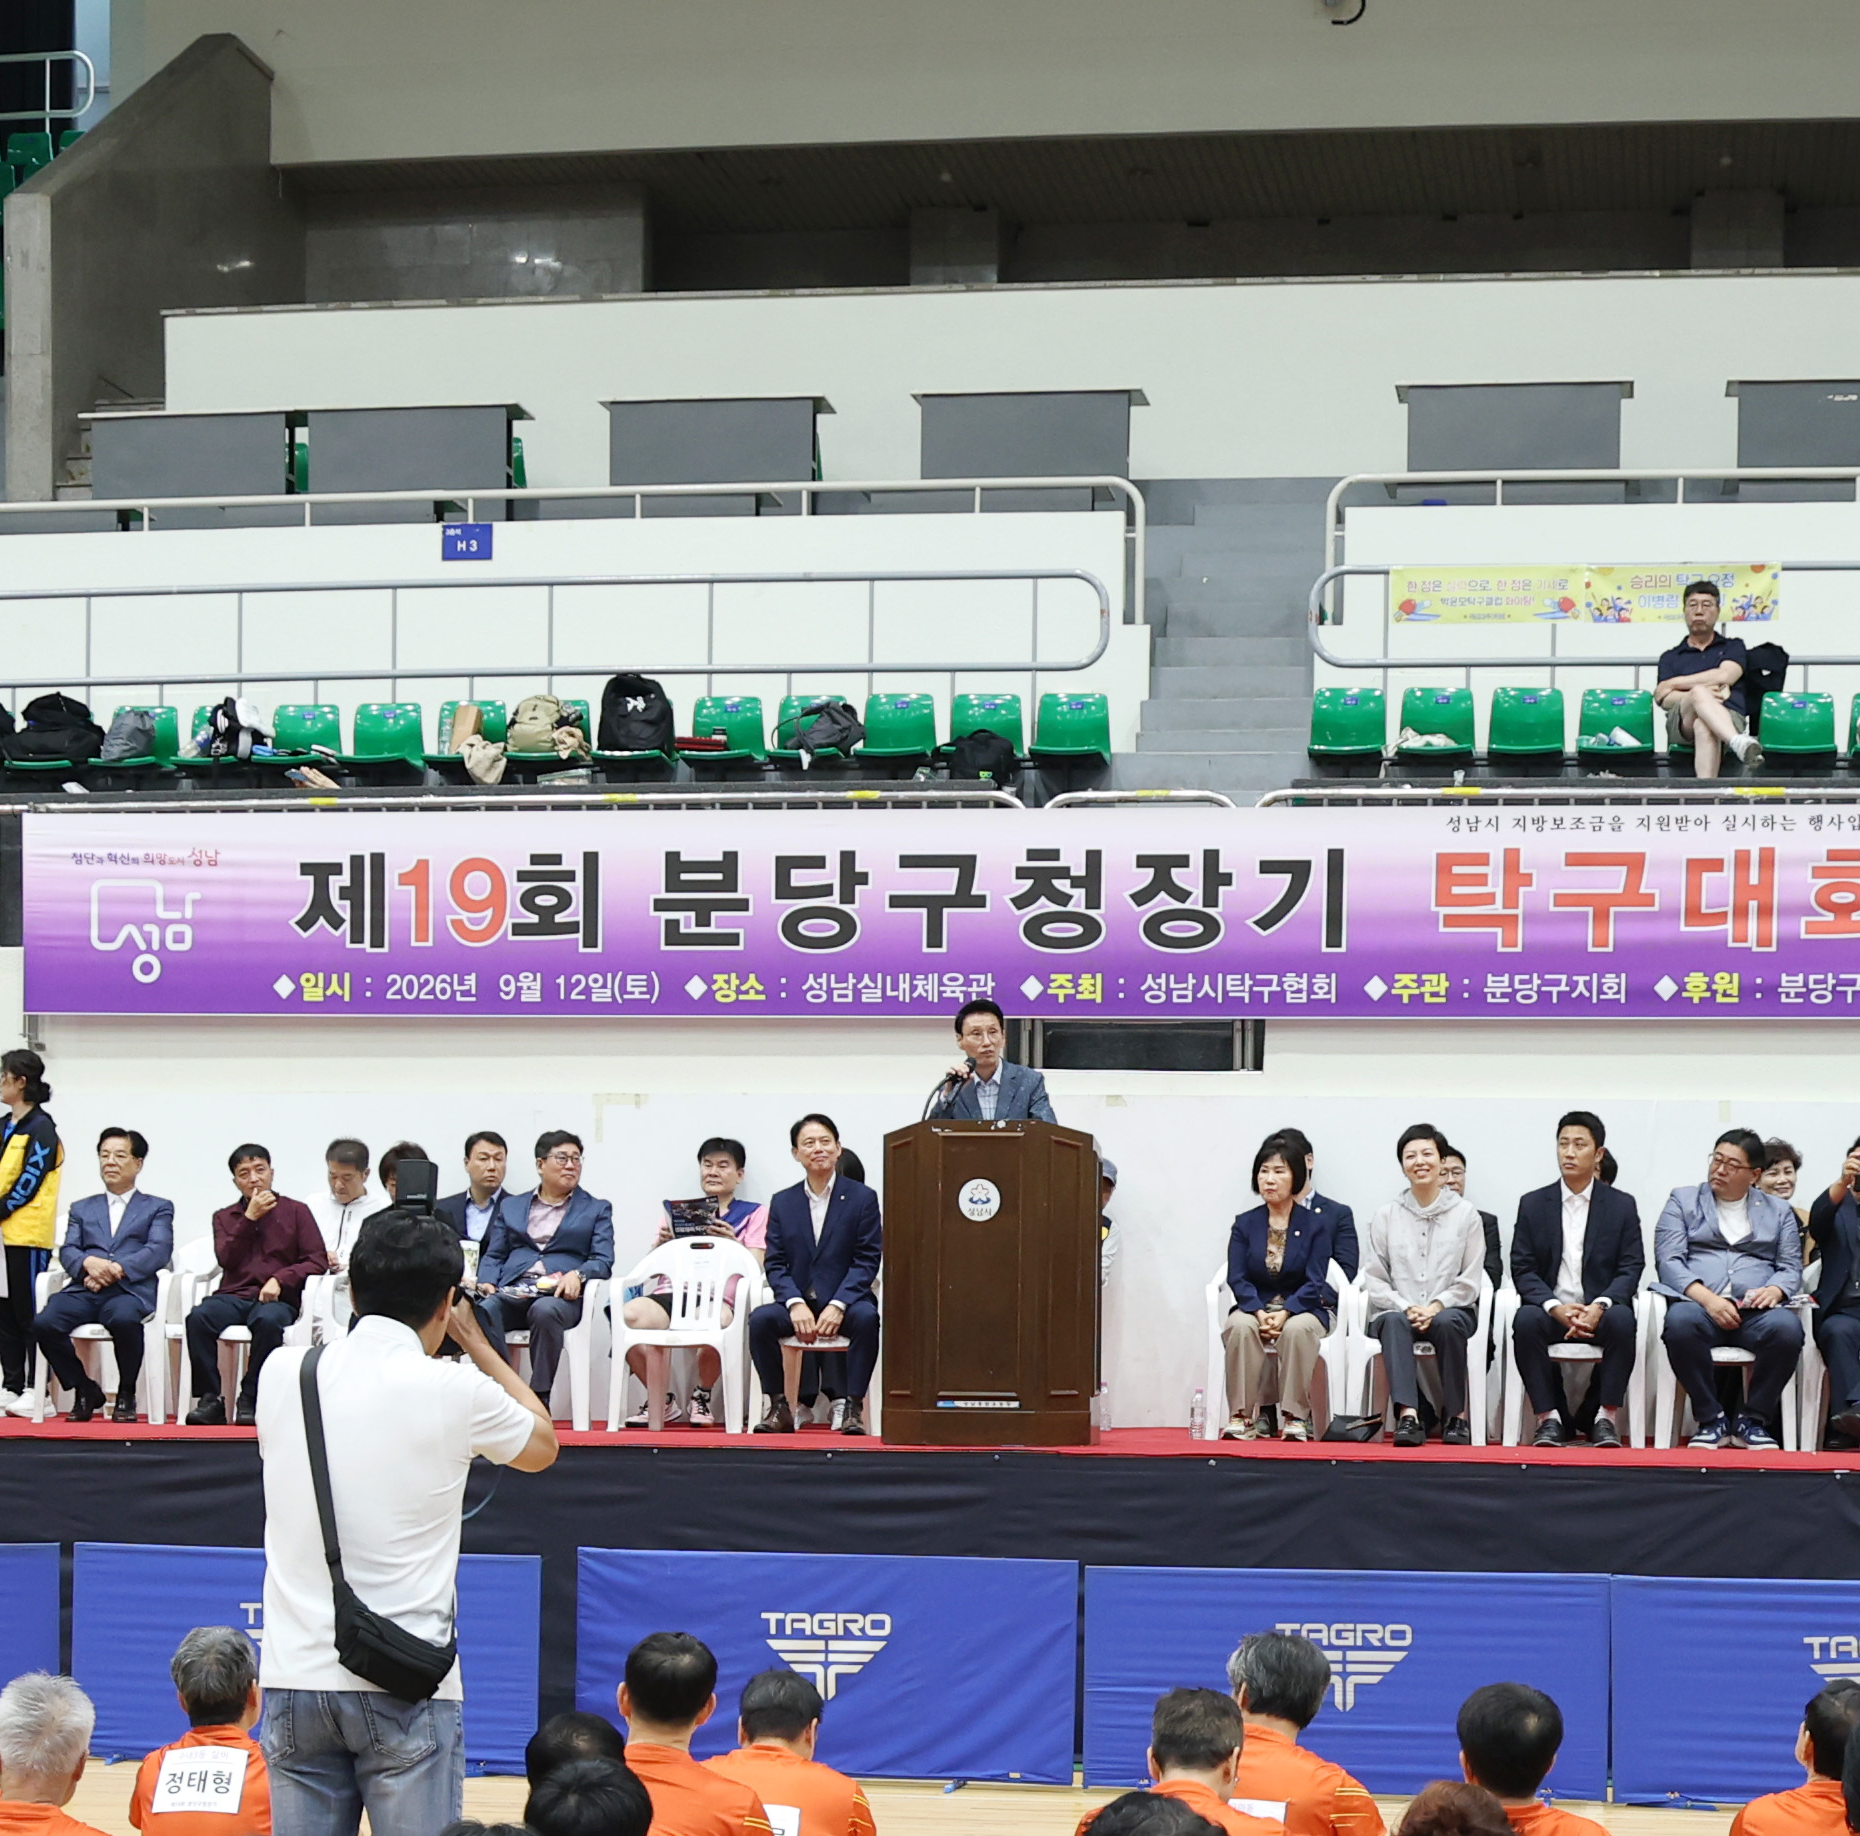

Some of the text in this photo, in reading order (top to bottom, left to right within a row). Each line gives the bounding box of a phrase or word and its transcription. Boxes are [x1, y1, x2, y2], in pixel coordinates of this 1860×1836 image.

[1630, 574, 1672, 589] 승리의
[1446, 815, 1501, 834] 성남시
[1511, 815, 1626, 834] 지방보조금을
[1635, 814, 1712, 834] 지원받아
[1722, 814, 1797, 834] 실시하는
[187, 848, 221, 867] 성남
[292, 849, 601, 950] 제19회
[652, 847, 1345, 950] 분당구청장기
[299, 972, 352, 1002] 일시
[386, 972, 478, 1002] 2026년
[499, 972, 542, 1002] 9월
[555, 971, 660, 1003] 12일(토)
[711, 972, 766, 1003] 장소
[802, 972, 995, 1003] 성남실내체육관
[1047, 973, 1103, 1003] 주최
[1140, 972, 1338, 1003] 성남시탁구협회
[1391, 972, 1449, 1004] 주관
[1483, 972, 1627, 1003] 분당구지회
[1681, 971, 1740, 1003] 후원
[761, 1612, 892, 1636] TAGRO
[1275, 1623, 1413, 1647] TAGRO
[165, 1770, 233, 1794] 정태형
